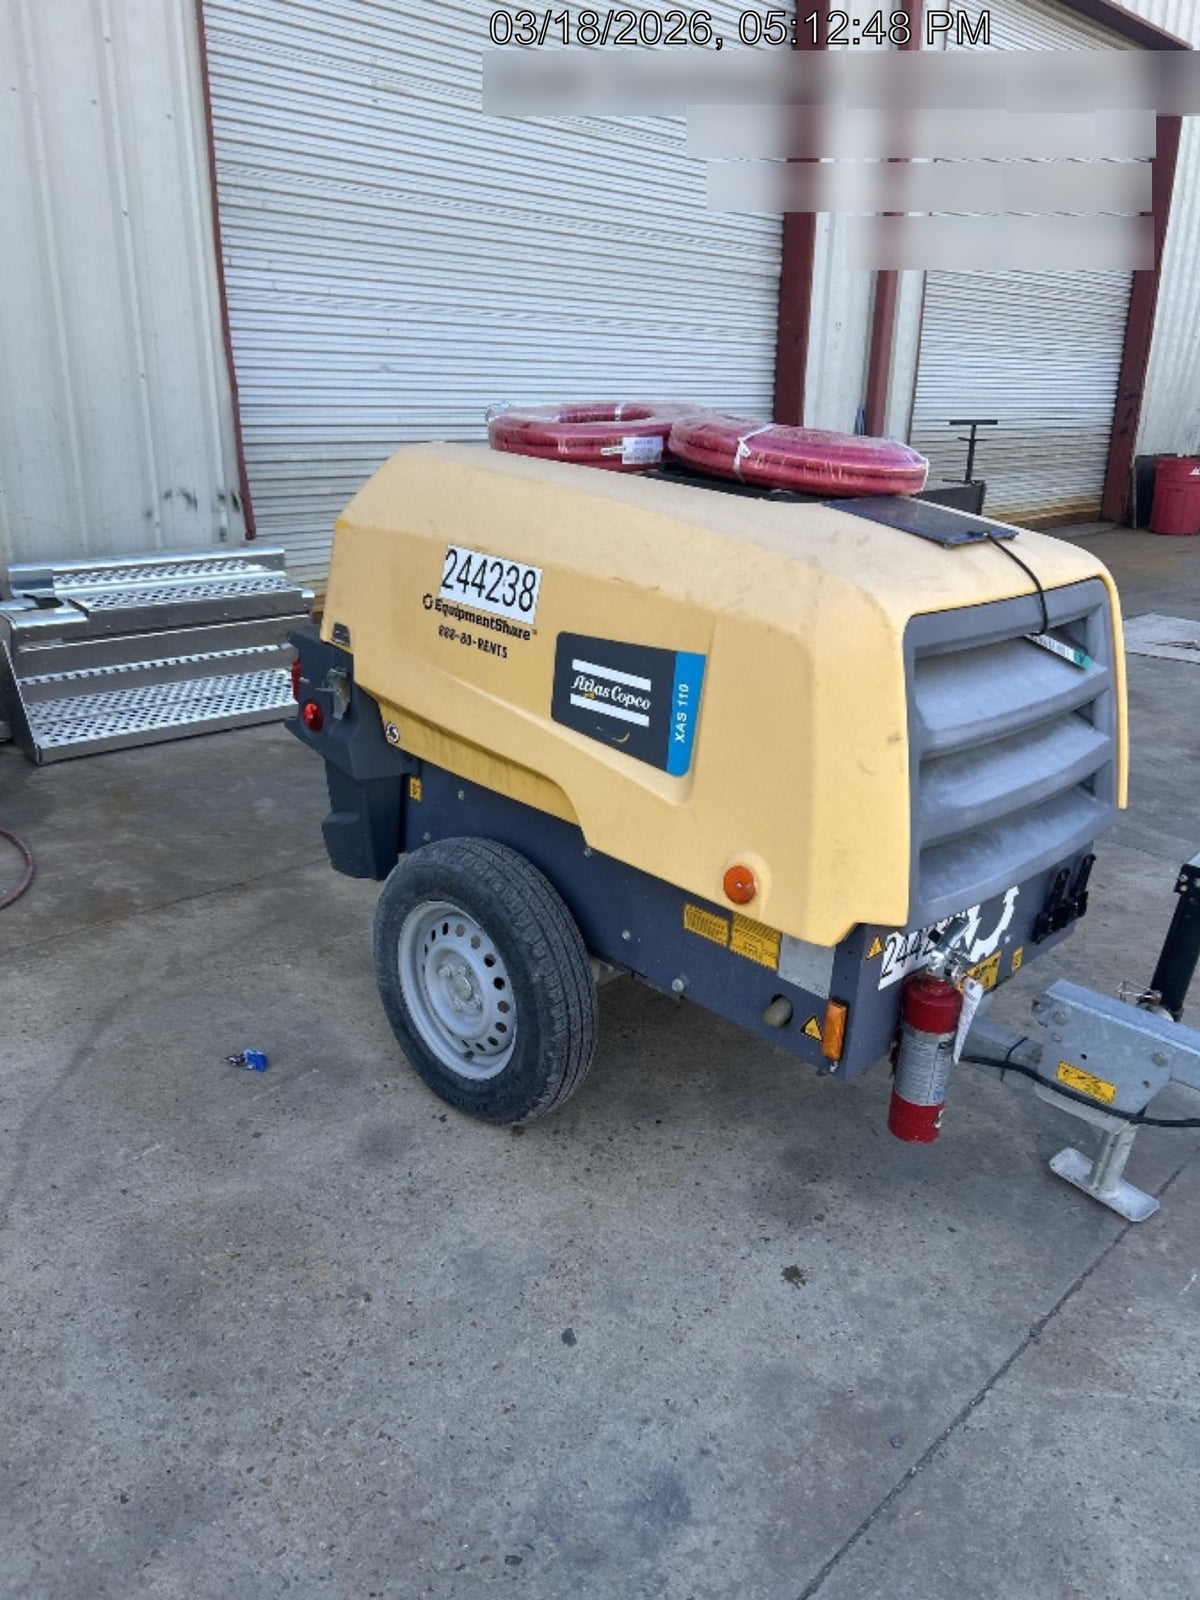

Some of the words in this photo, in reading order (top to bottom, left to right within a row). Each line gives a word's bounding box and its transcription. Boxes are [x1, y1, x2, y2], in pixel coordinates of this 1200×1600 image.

[441, 548, 537, 613] 244238
[434, 598, 531, 641] EquipmentShare
[571, 675, 610, 698] Atlas
[611, 685, 651, 710] Copco
[678, 683, 690, 706] 110
[674, 712, 688, 743] XAS
